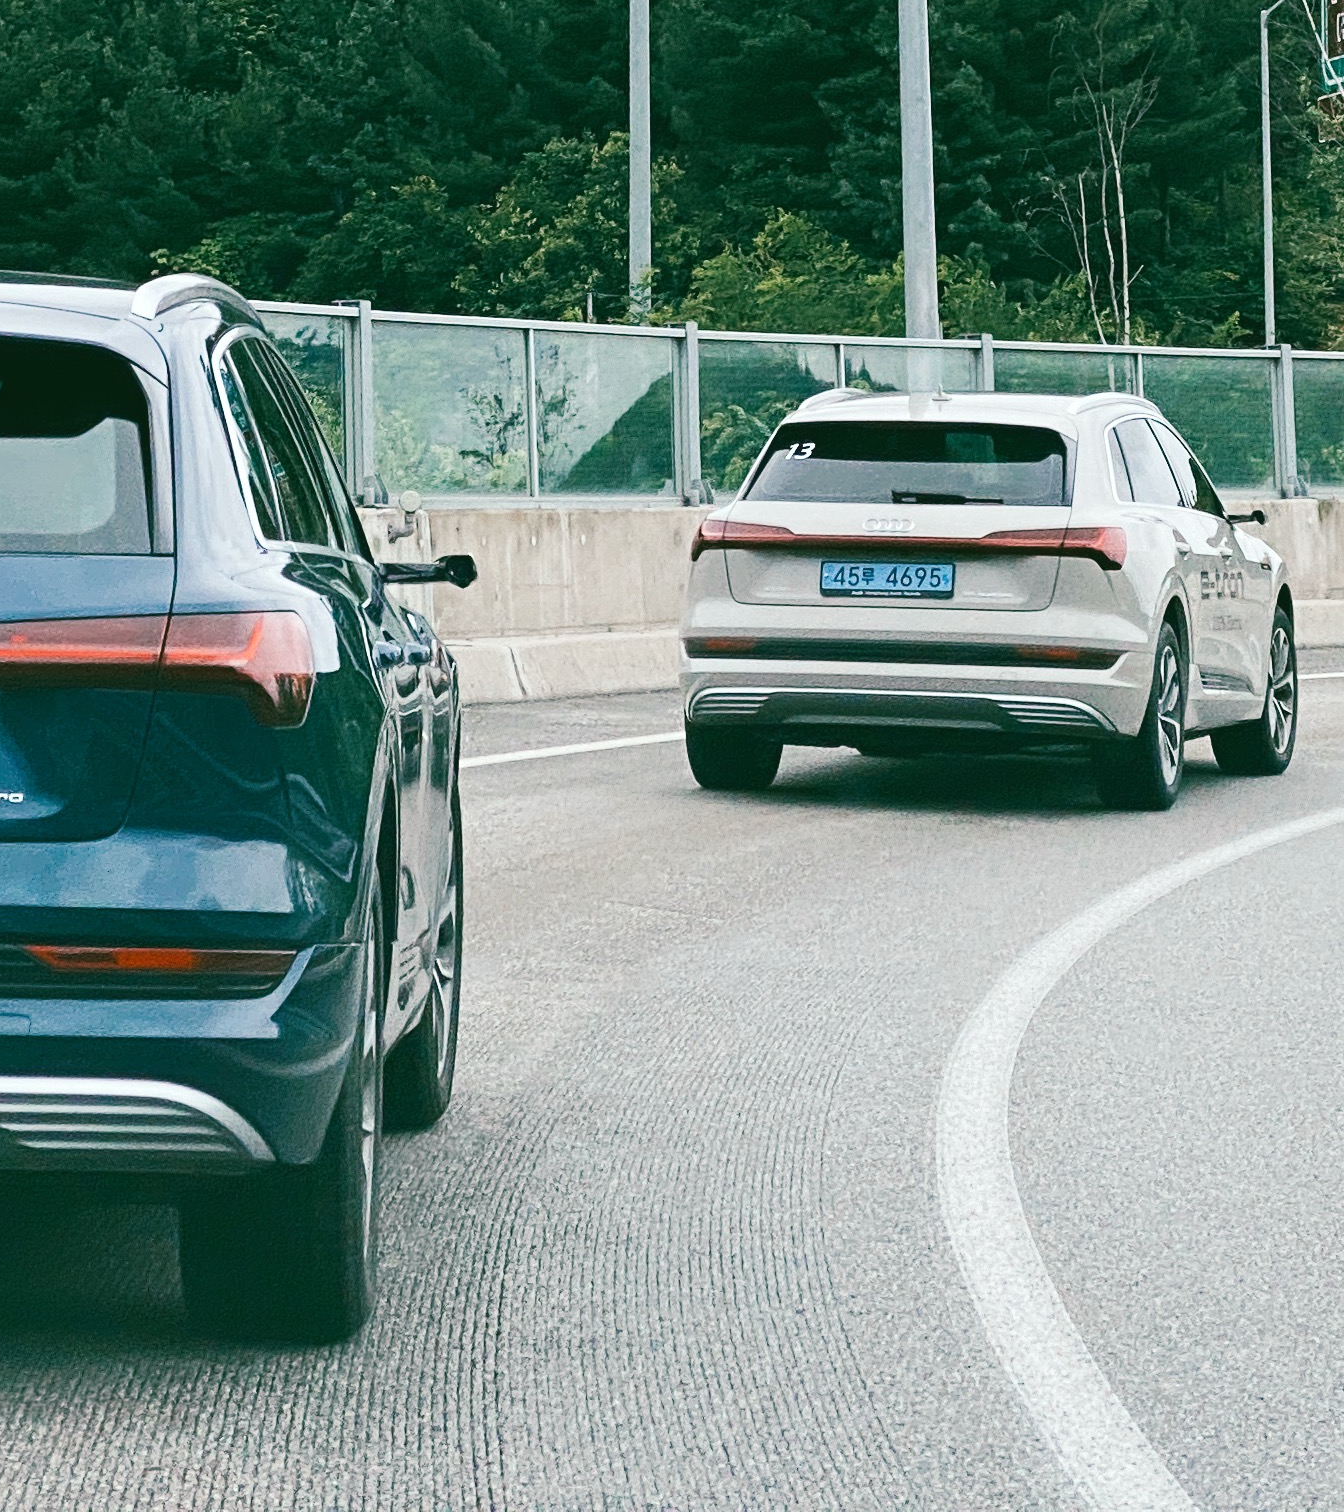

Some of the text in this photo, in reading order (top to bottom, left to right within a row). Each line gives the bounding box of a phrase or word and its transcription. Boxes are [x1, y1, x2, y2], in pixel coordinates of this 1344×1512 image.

[784, 442, 816, 460] 13
[833, 566, 942, 589] 45루 4695
